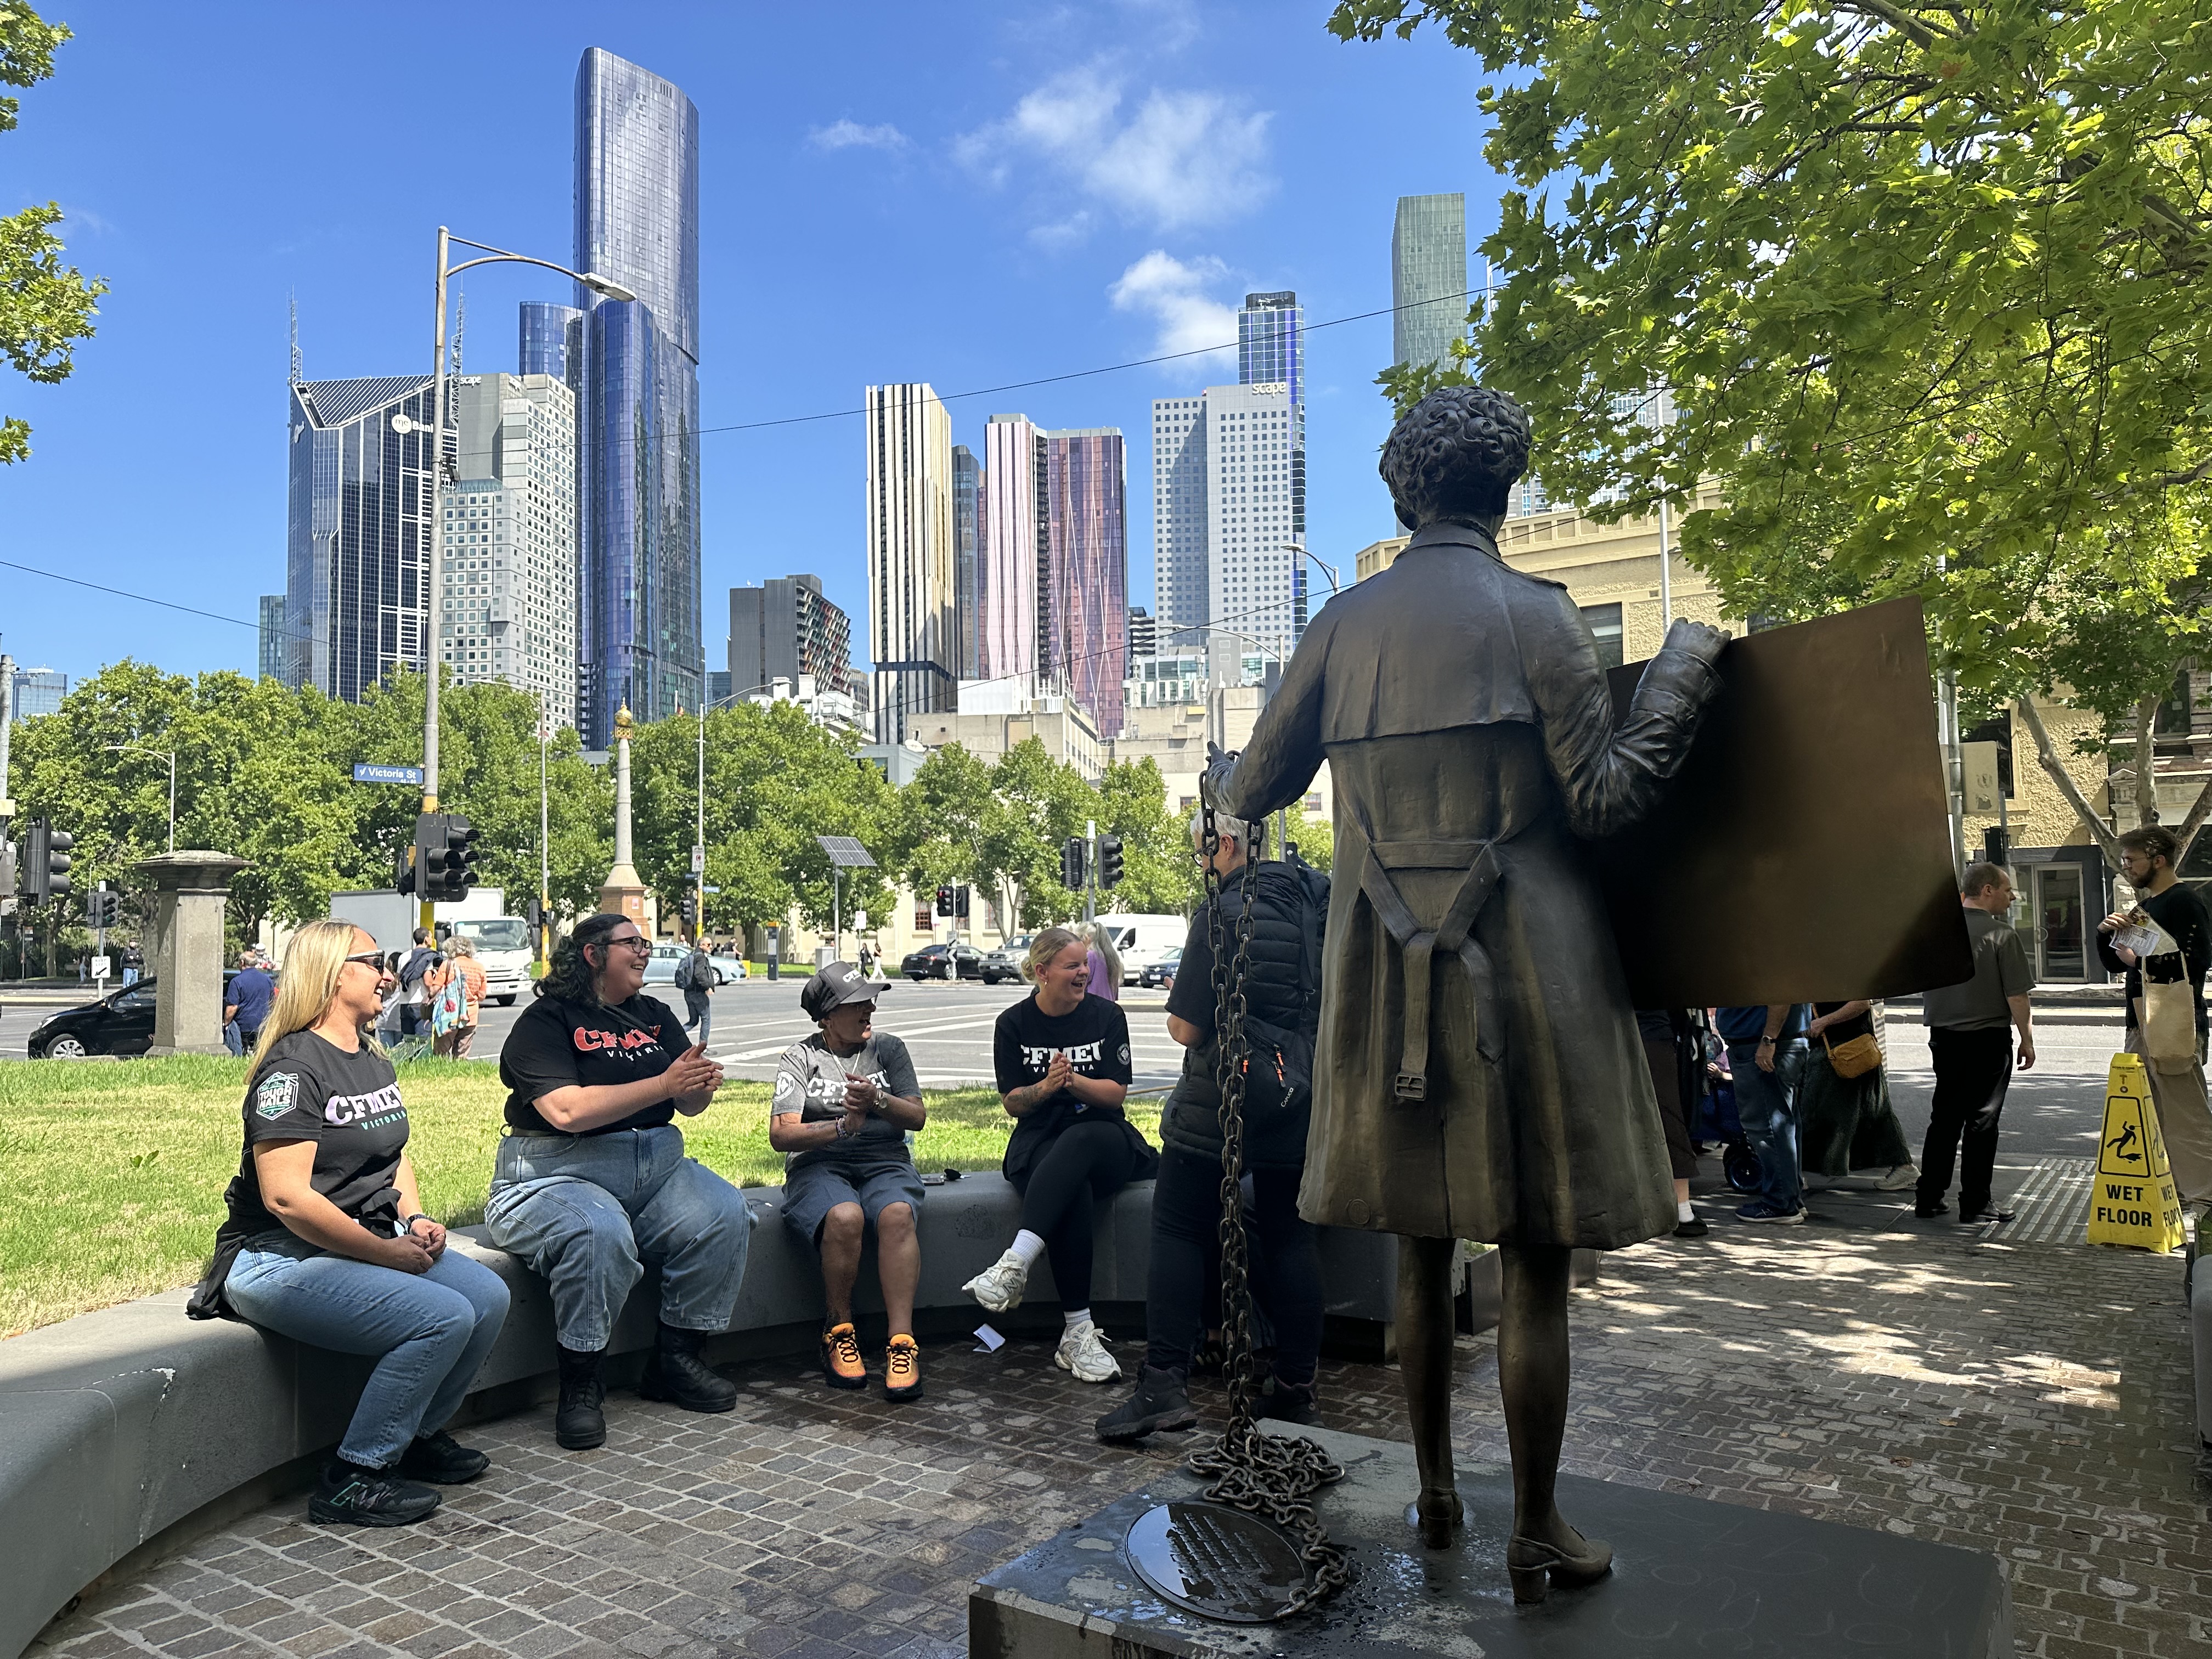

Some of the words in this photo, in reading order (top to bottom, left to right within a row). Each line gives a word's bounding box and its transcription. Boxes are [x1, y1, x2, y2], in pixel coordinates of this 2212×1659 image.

[1252, 381, 1287, 397] scape
[368, 766, 404, 778] Victoria
[406, 769, 416, 779] St
[259, 1086, 293, 1101] TOUGH
[259, 1095, 291, 1110] NAILS
[360, 1110, 407, 1131] VICTORIA
[2106, 1184, 2144, 1202] WET
[2160, 1184, 2175, 1202] WET
[2097, 1206, 2153, 1227] FLOOR
